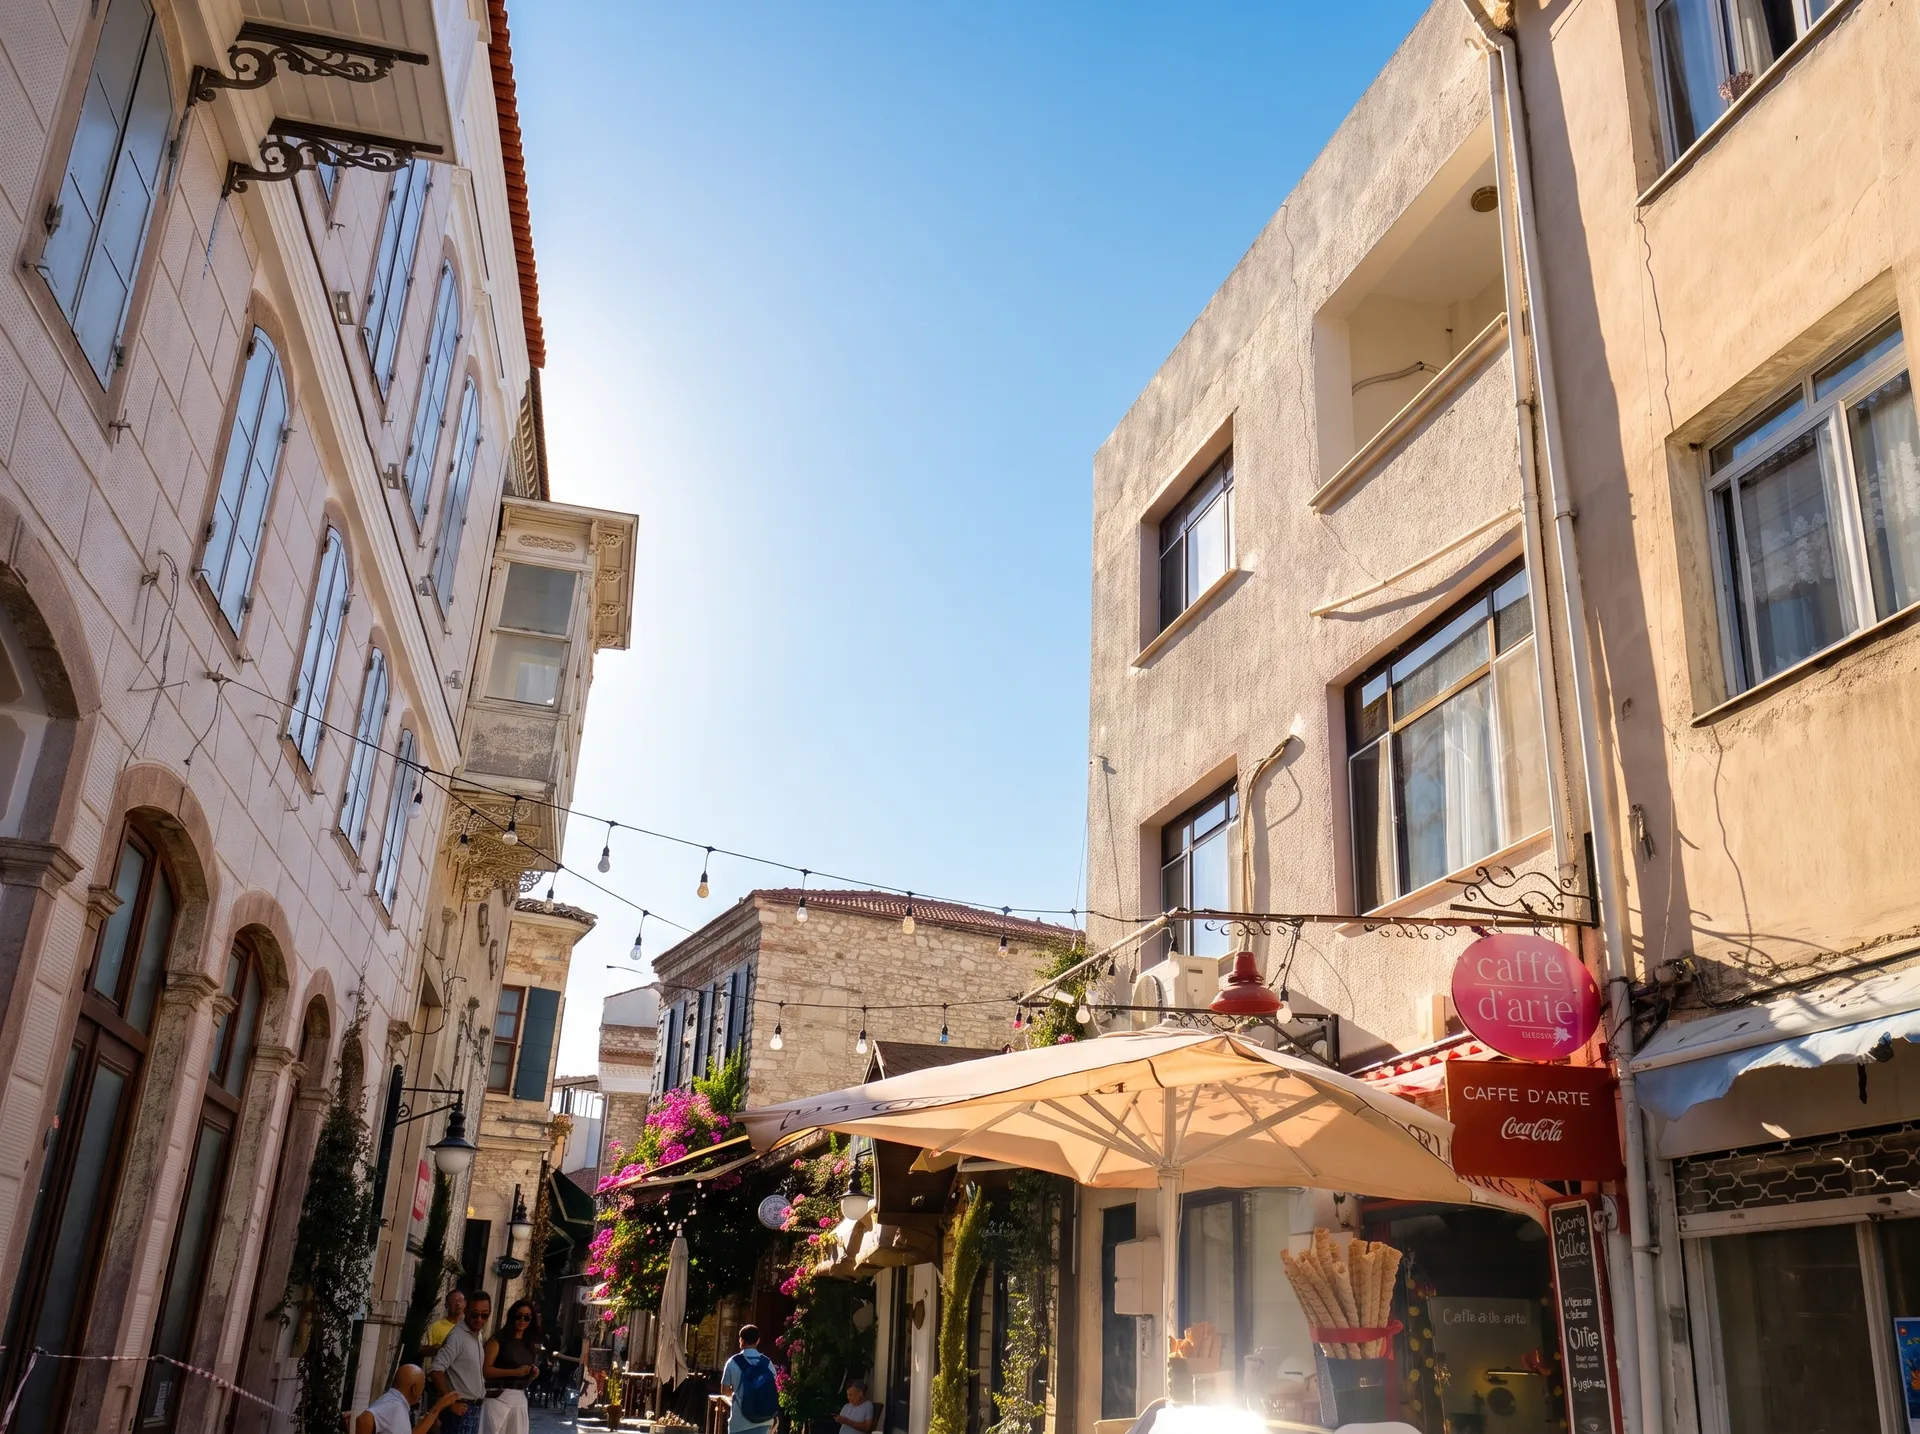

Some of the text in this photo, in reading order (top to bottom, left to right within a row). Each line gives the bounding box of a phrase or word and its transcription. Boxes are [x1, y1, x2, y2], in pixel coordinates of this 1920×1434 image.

[1463, 1086, 1591, 1106] CAFFE D'ARTE
[1501, 1116, 1565, 1142] Coca-Cola
